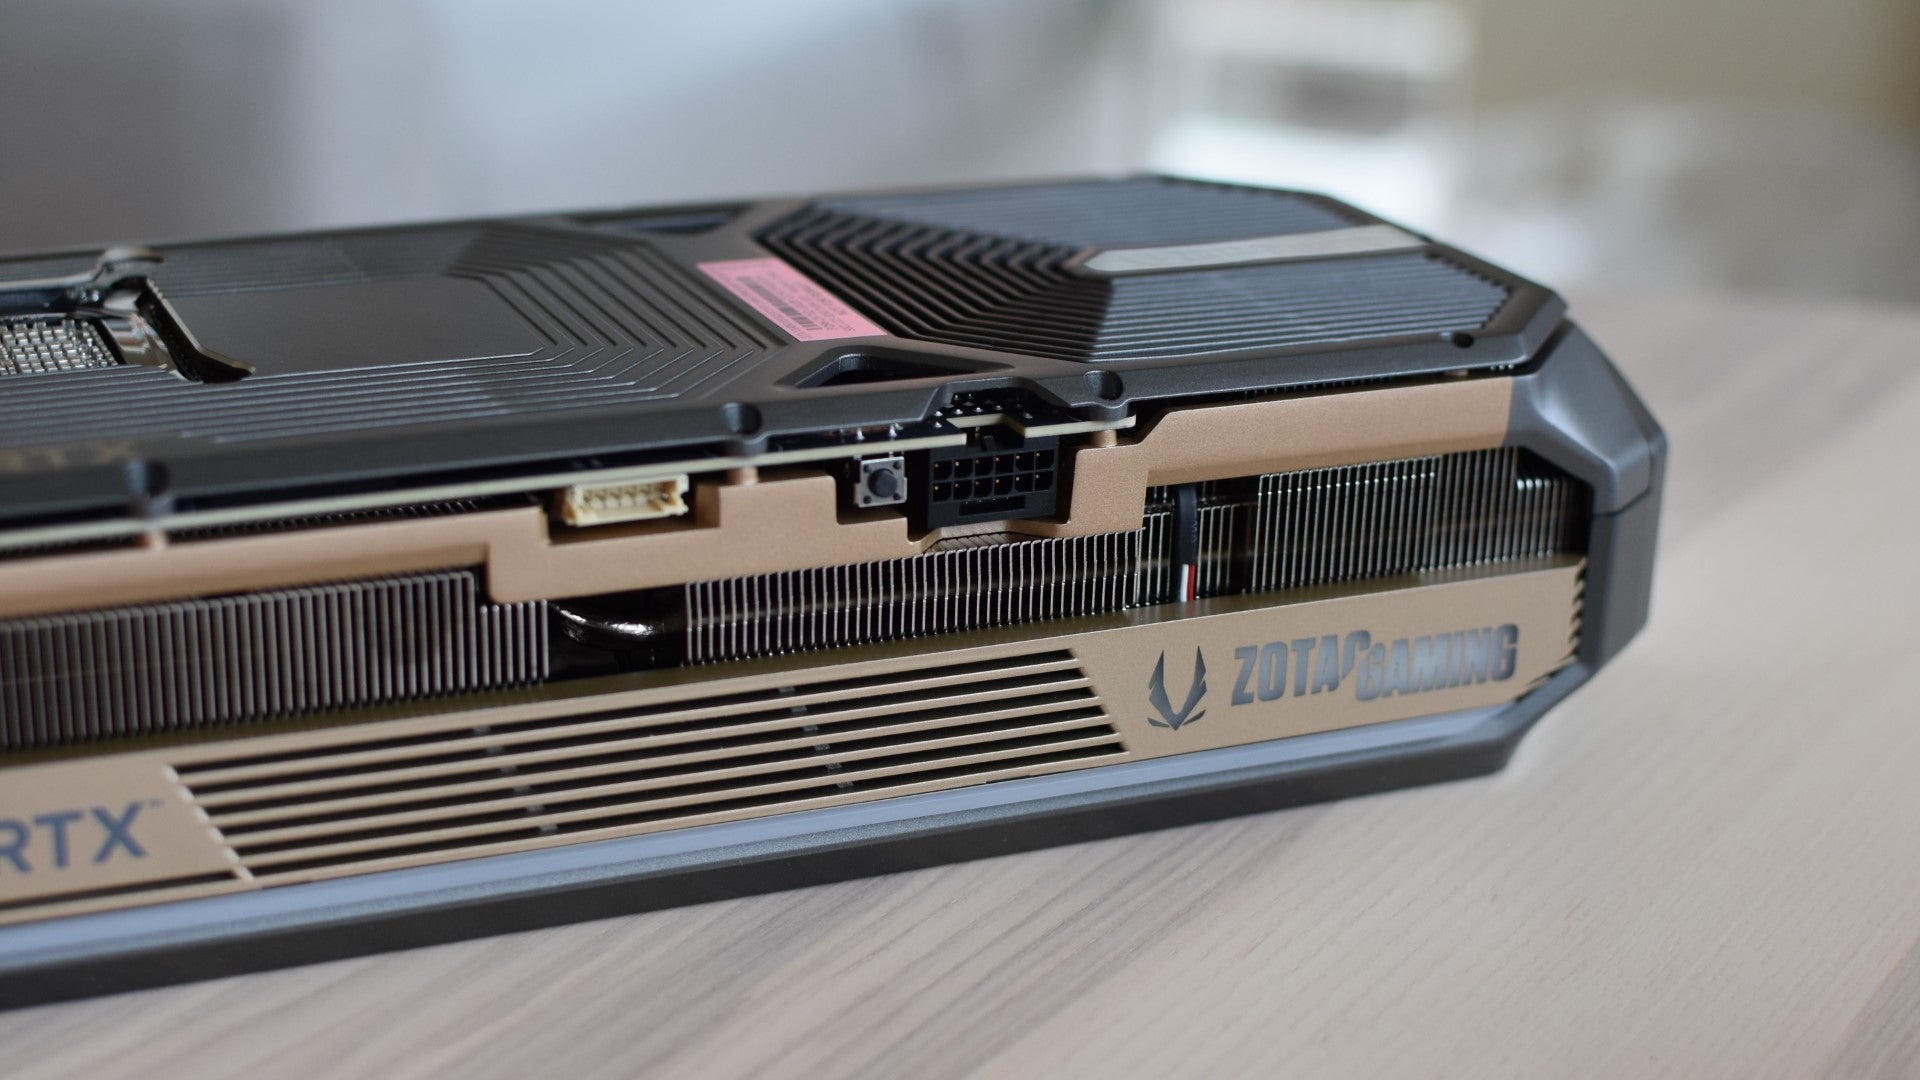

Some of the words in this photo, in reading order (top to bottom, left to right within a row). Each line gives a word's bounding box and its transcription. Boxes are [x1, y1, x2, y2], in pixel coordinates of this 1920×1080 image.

[1231, 629, 1371, 706] ZOTAC
[1355, 624, 1519, 700] GAMING
[0, 802, 147, 873] RTX
